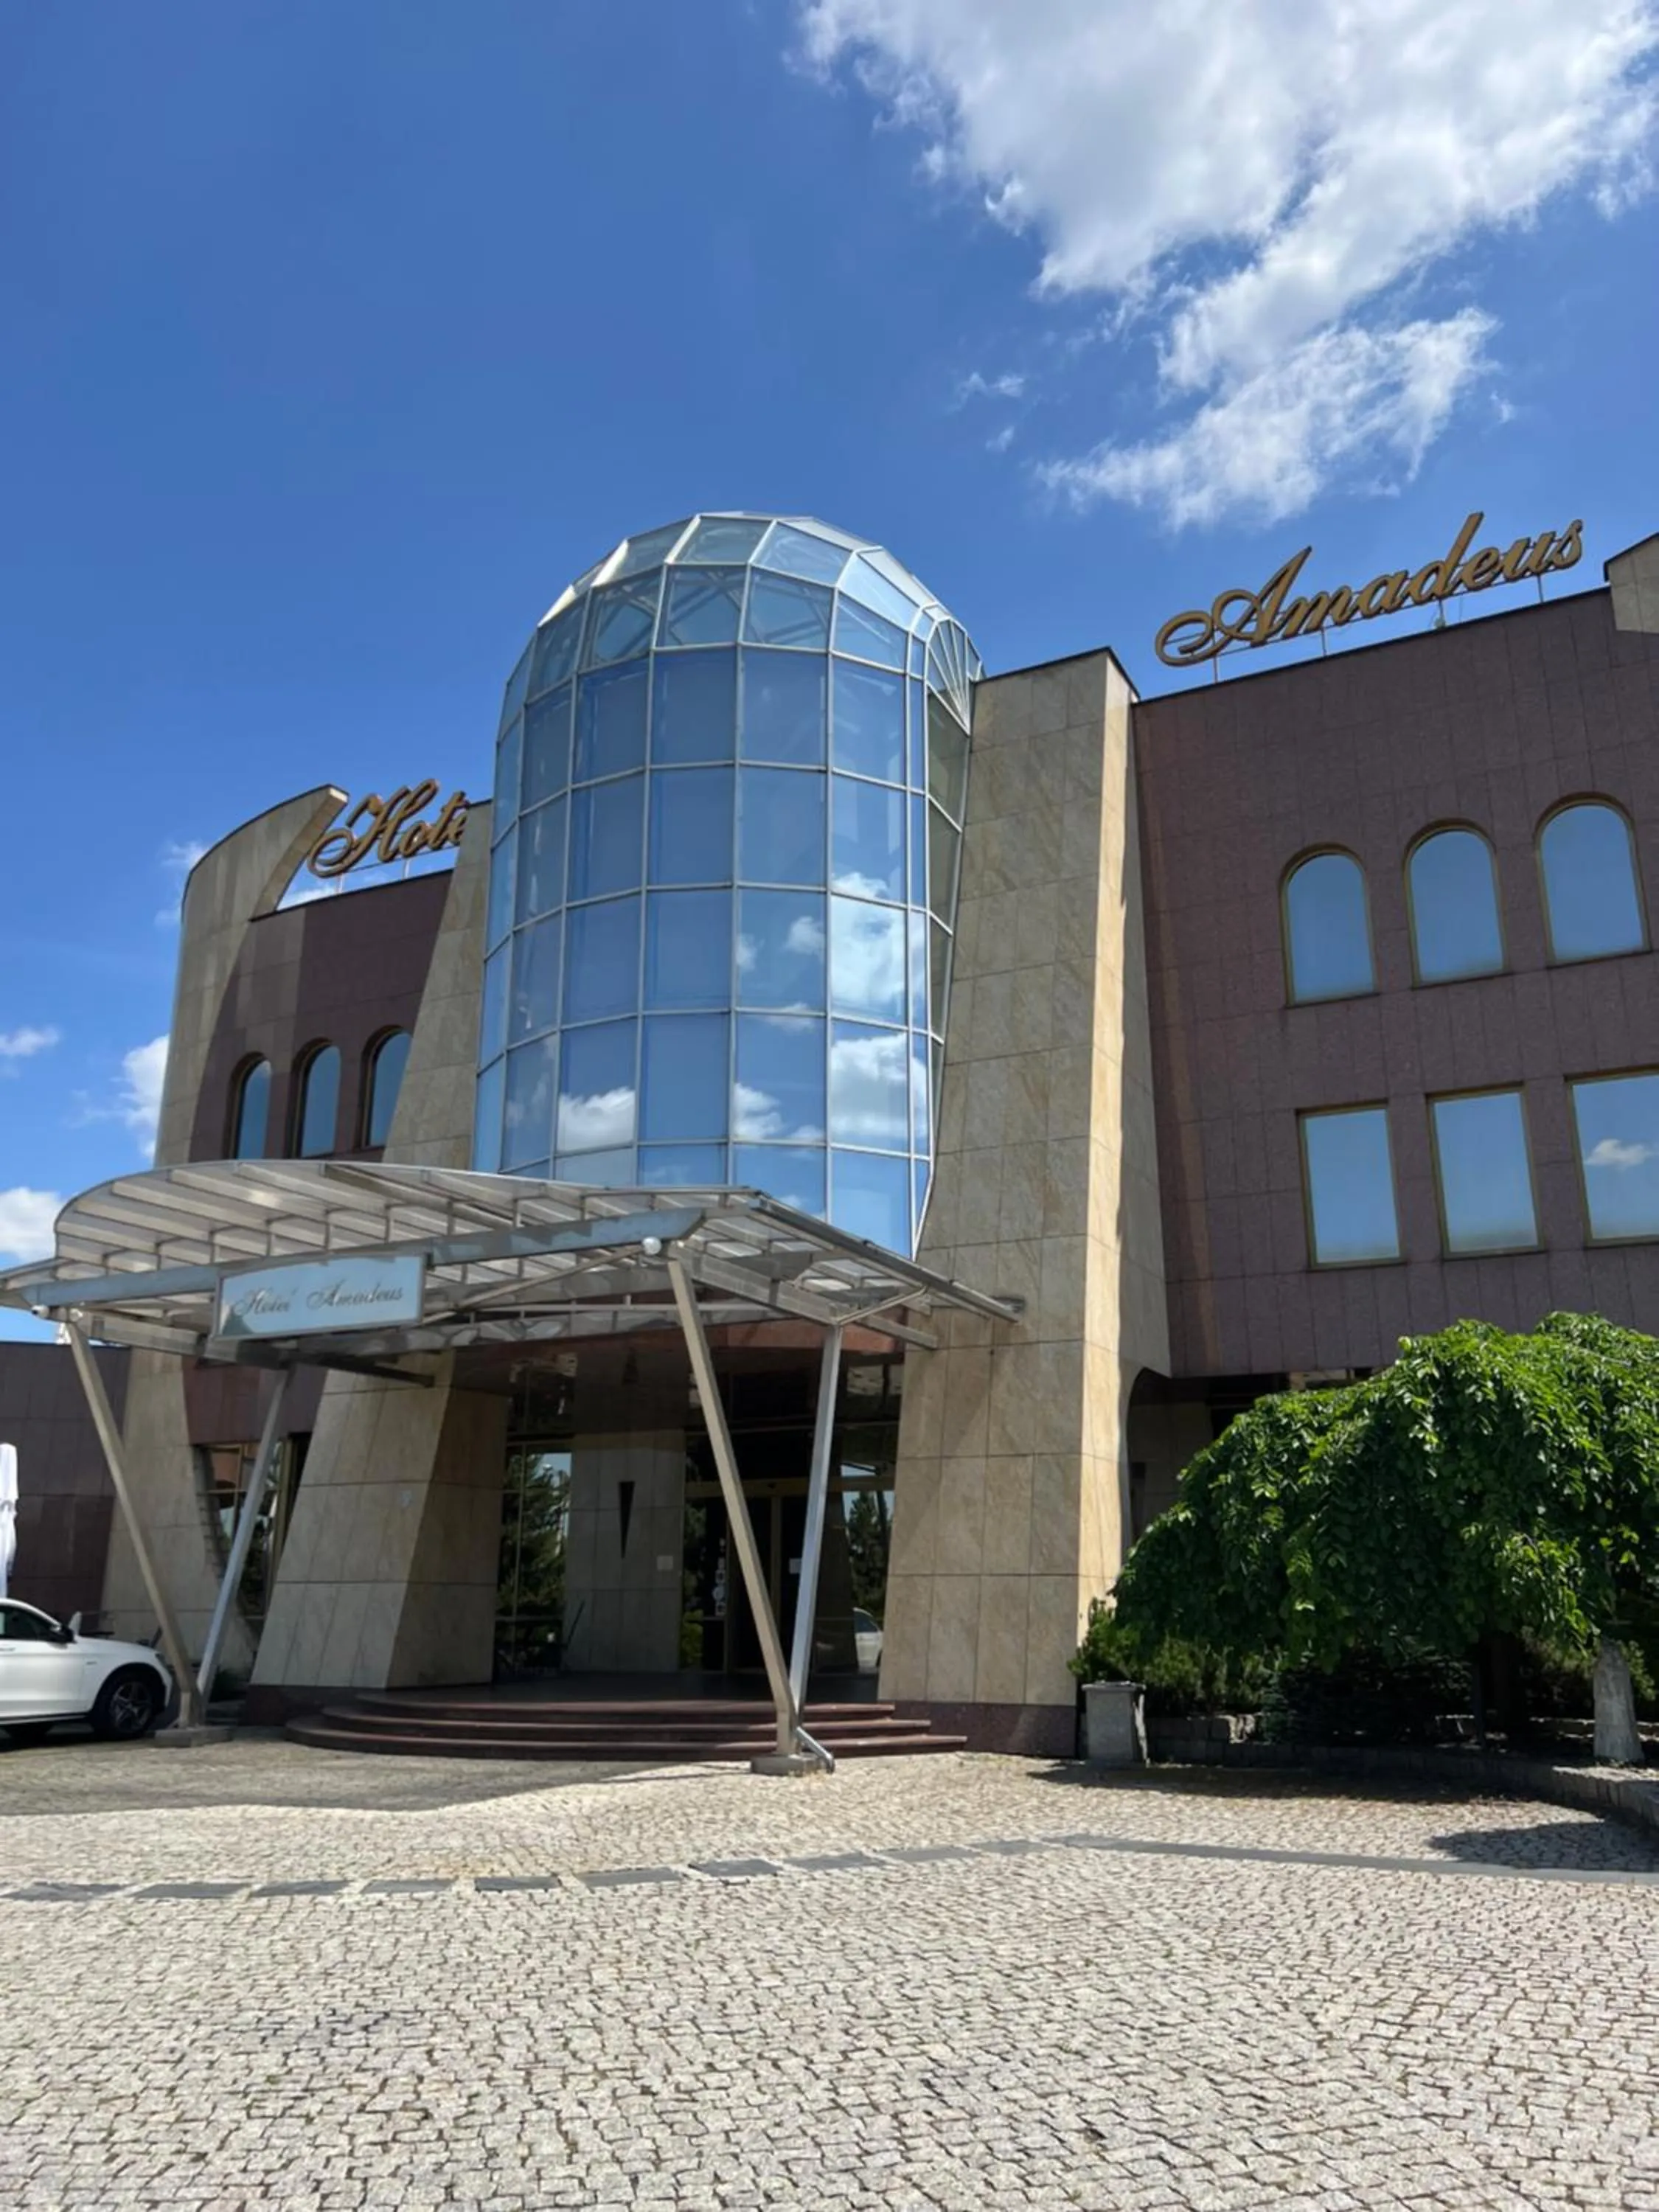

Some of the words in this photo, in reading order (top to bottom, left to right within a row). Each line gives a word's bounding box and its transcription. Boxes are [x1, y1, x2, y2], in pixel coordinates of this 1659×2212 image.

[1155, 510, 1584, 667] Amadeus
[307, 779, 470, 880] Hote
[305, 1278, 404, 1311] Amadeus
